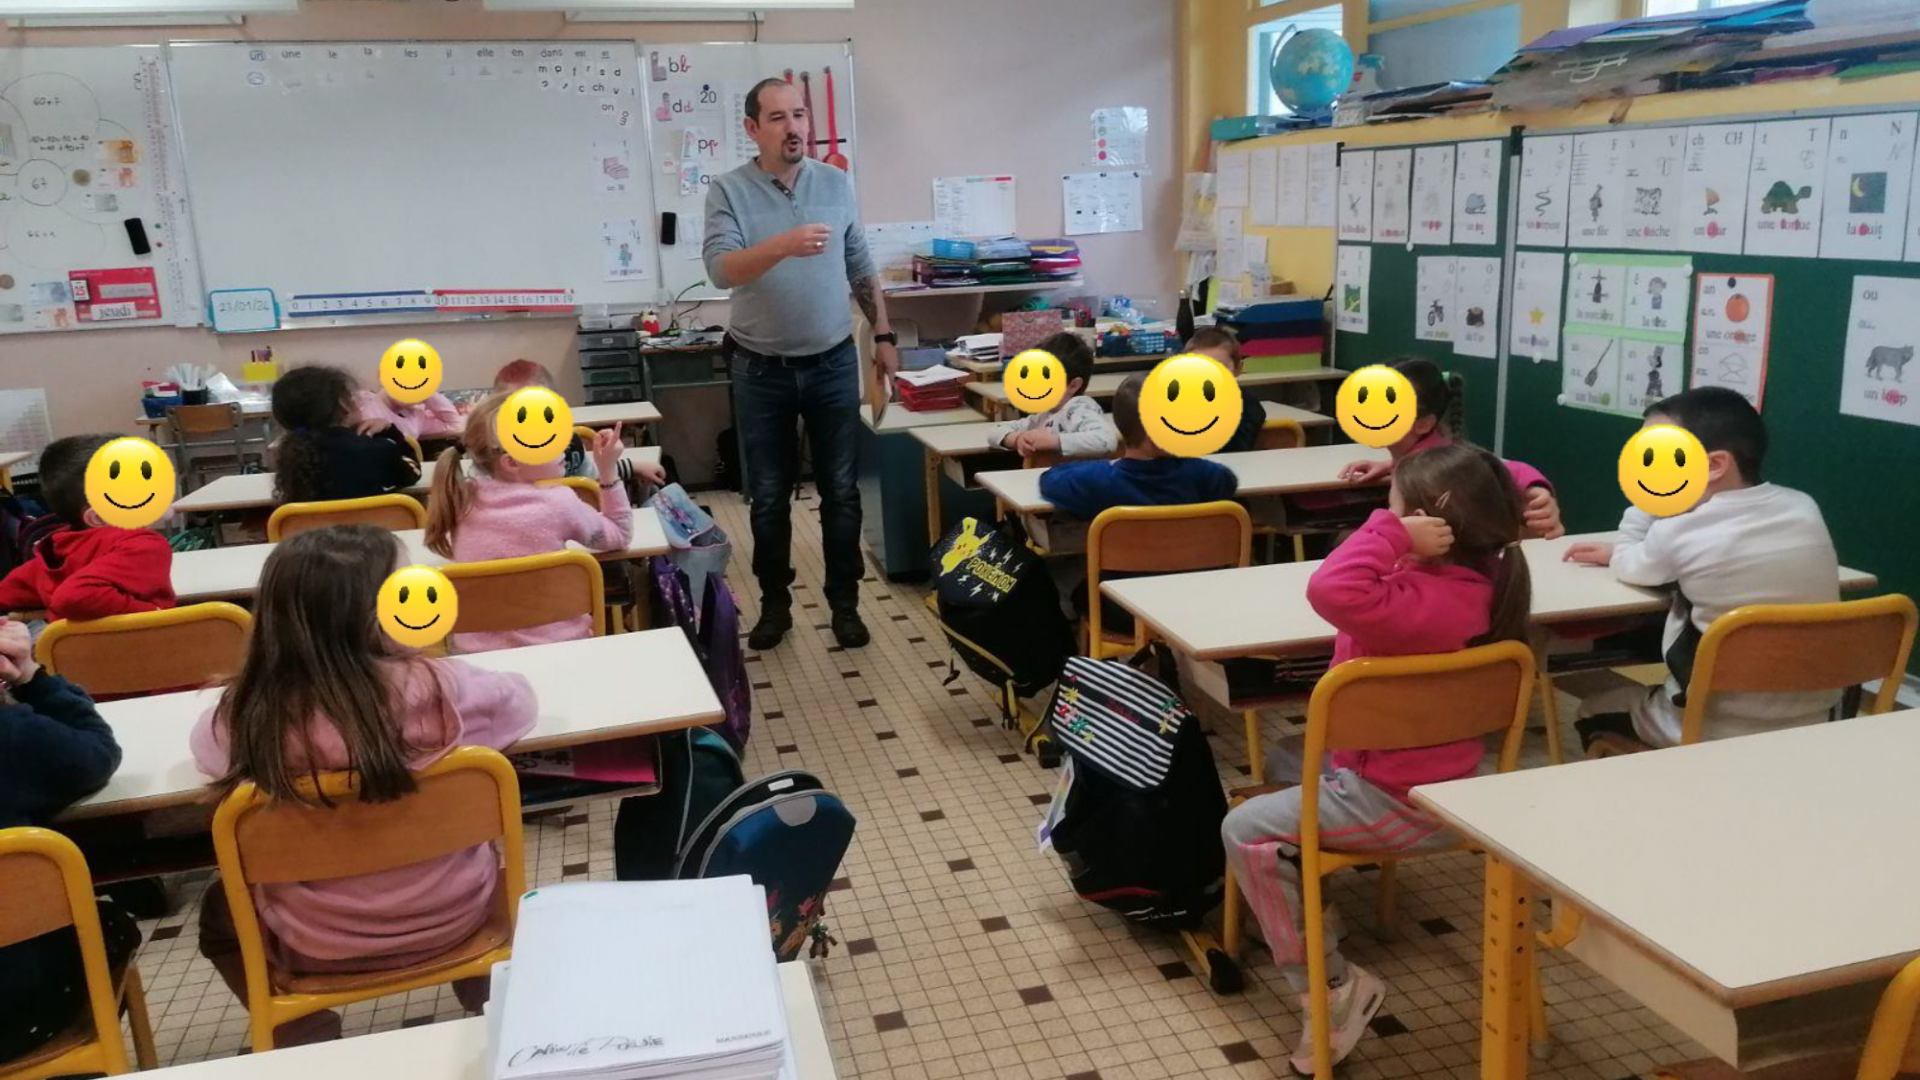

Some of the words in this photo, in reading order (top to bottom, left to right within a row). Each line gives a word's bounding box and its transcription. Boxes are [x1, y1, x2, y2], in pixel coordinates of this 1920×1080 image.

[281, 50, 302, 59] une
[511, 49, 525, 57] en
[541, 49, 563, 58] dans
[700, 90, 718, 104] 20
[1807, 128, 1818, 142] T
[1890, 120, 1902, 136] N
[1725, 131, 1743, 145] CH
[1863, 290, 1879, 301] ou
[98, 303, 132, 319] jeudi
